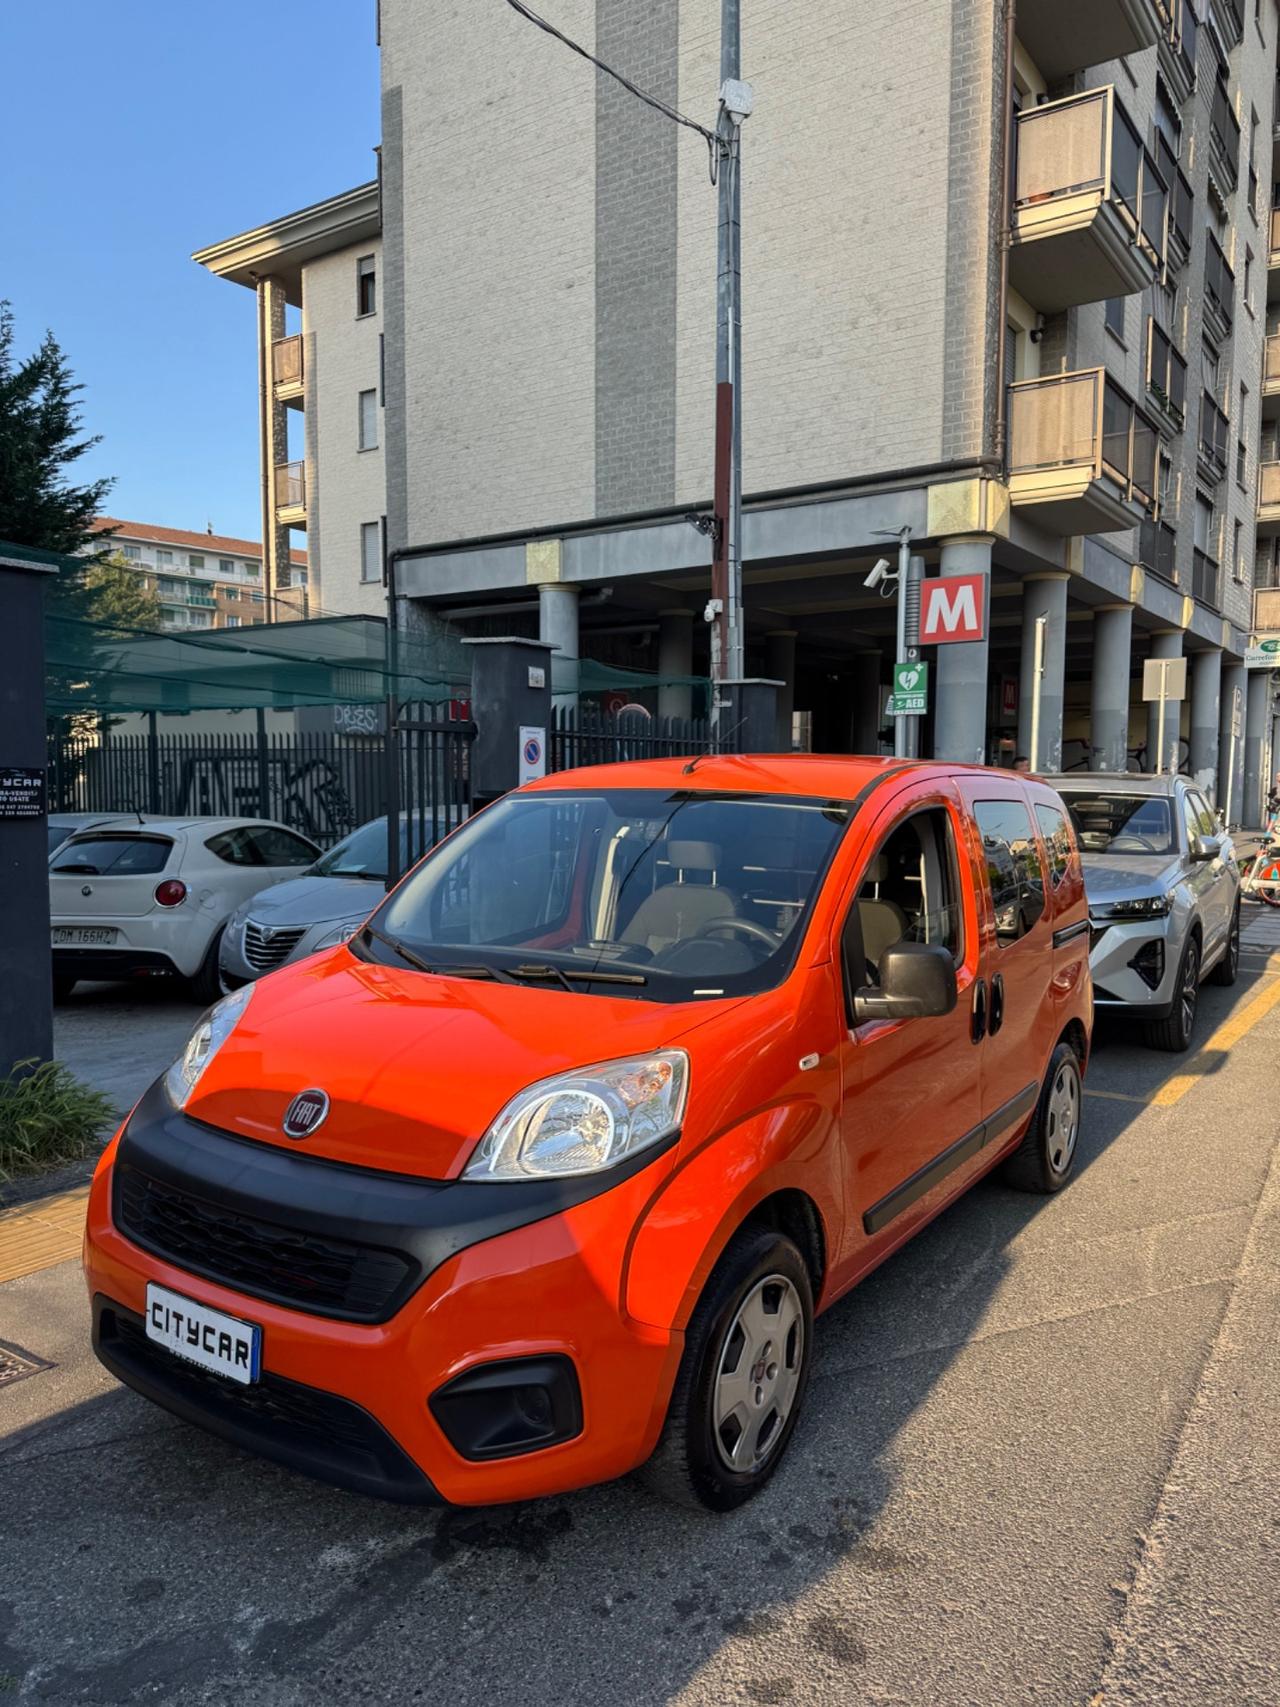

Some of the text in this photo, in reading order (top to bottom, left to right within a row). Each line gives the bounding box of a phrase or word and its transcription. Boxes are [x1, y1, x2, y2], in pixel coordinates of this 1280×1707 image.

[924, 584, 978, 634] M
[905, 698, 925, 709] AED
[0, 778, 42, 787] YCAR
[290, 1100, 321, 1126] FIAT
[152, 1302, 249, 1370] CITYCAR
